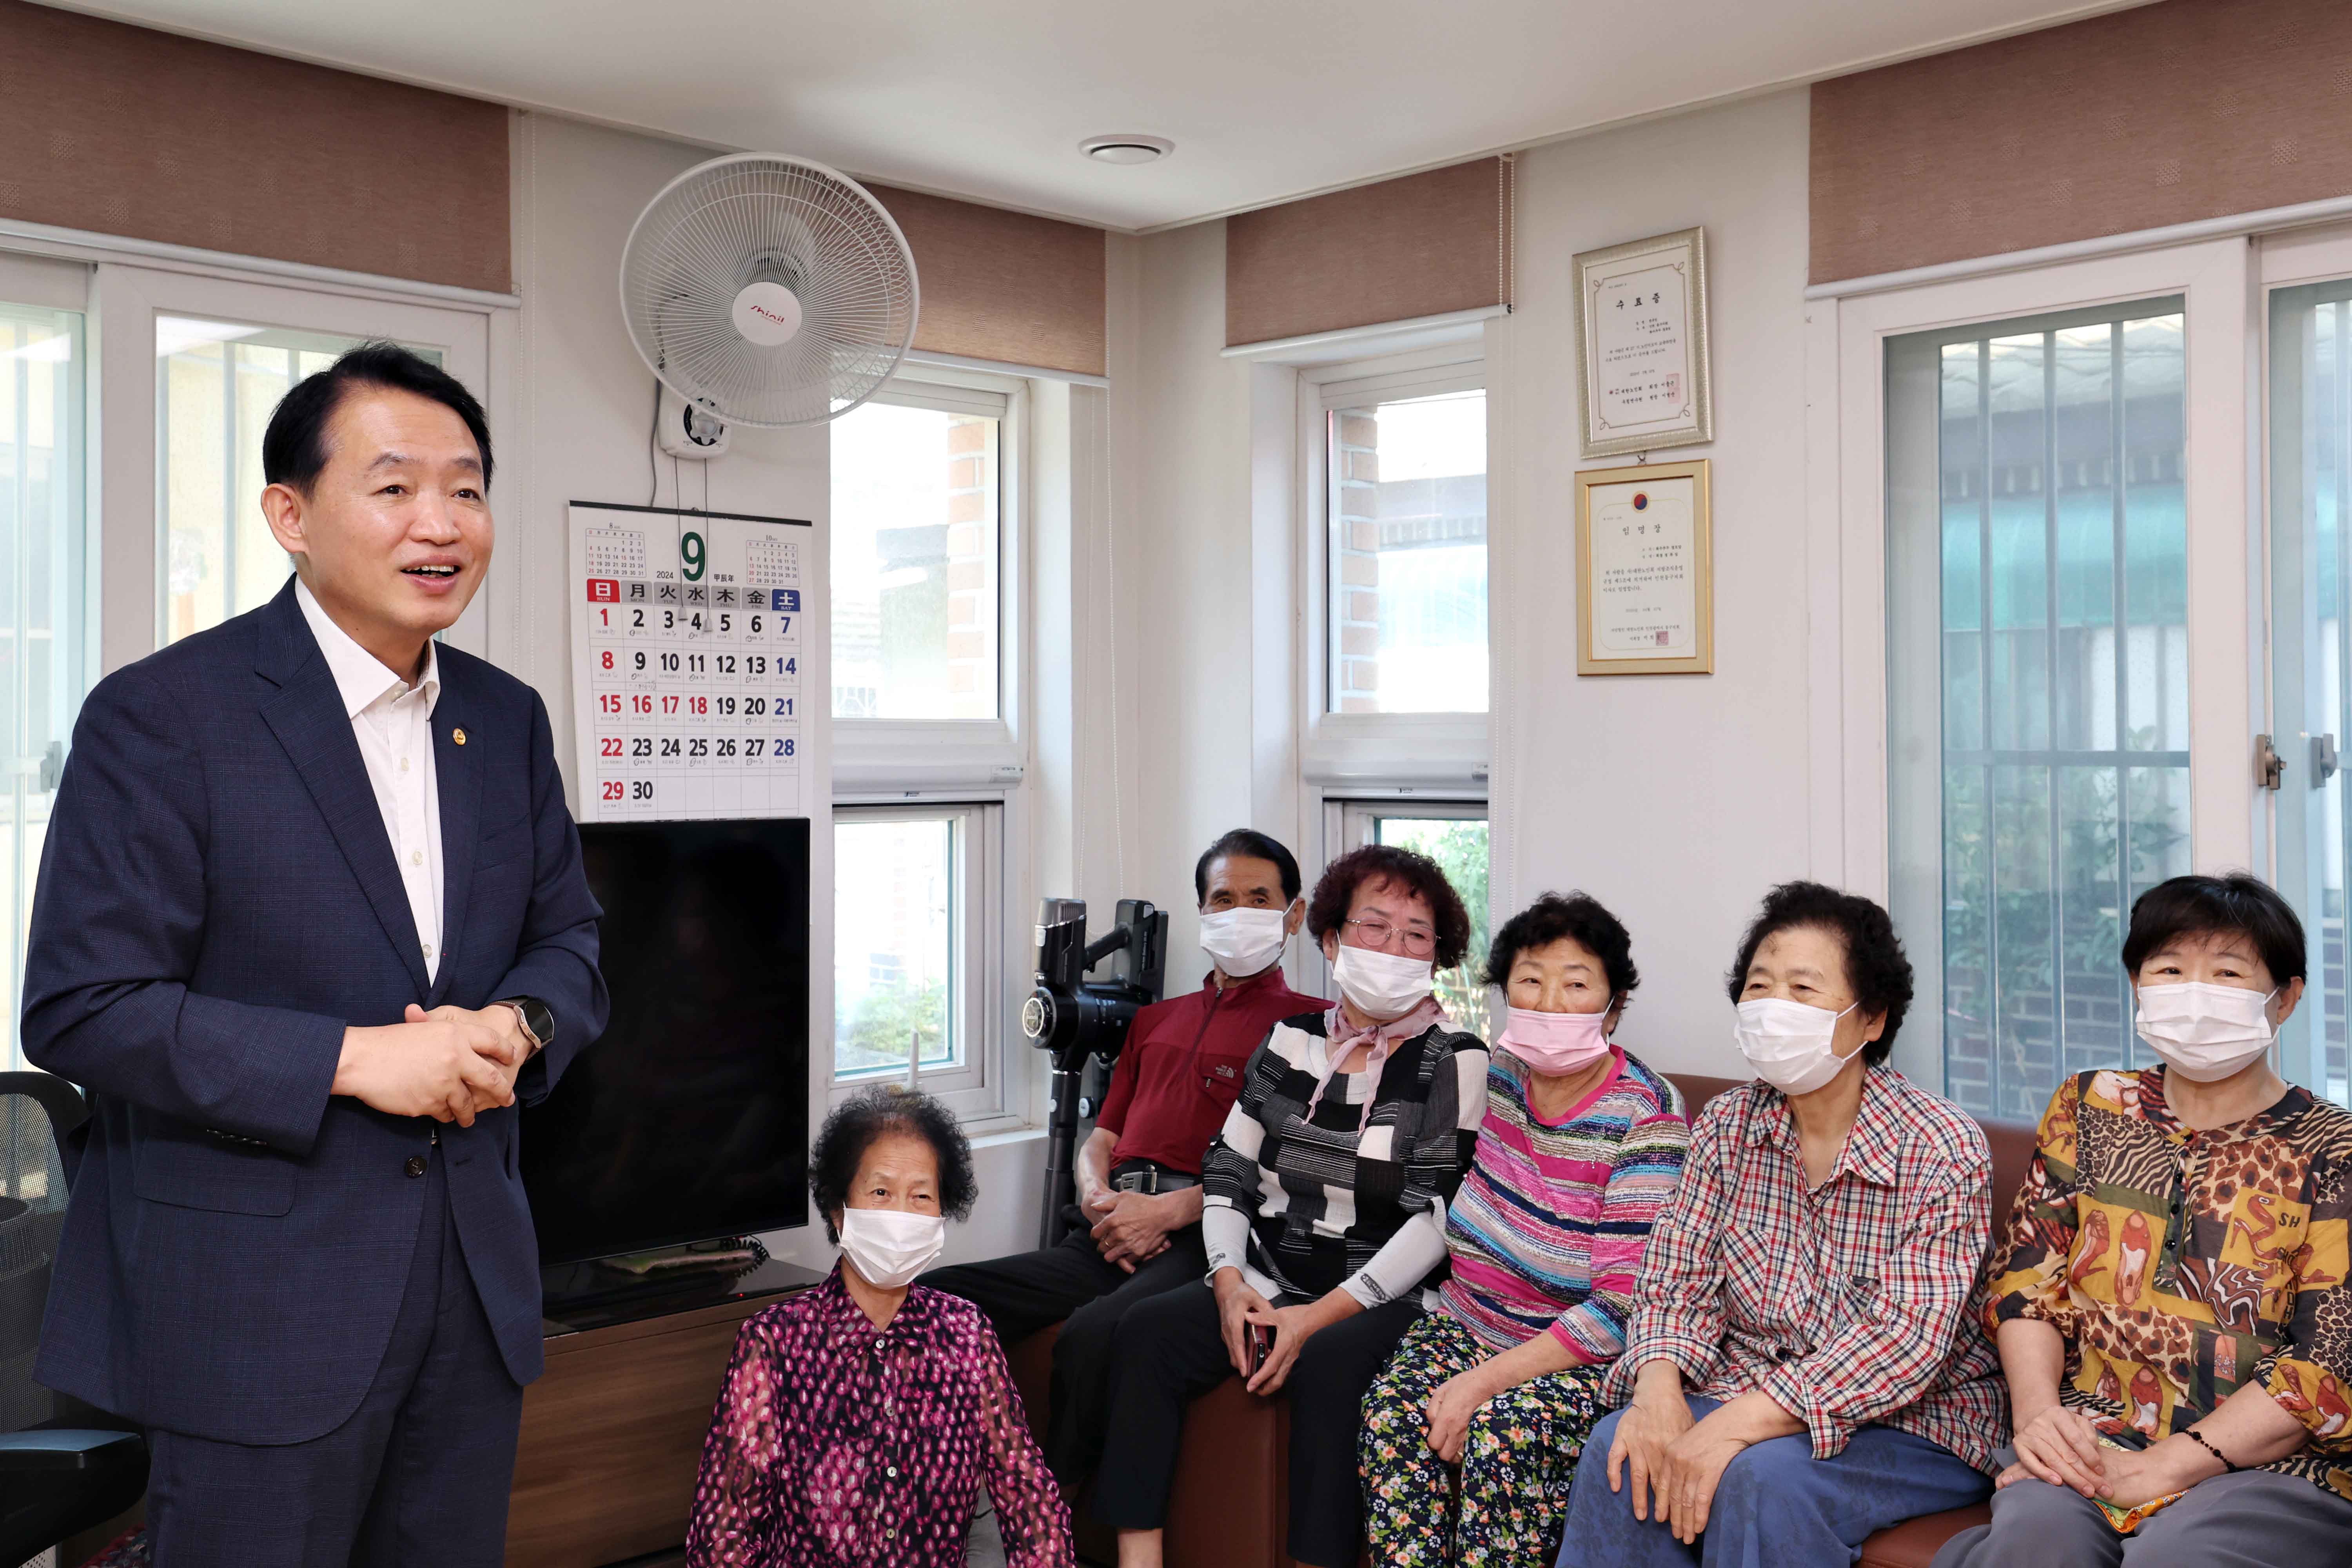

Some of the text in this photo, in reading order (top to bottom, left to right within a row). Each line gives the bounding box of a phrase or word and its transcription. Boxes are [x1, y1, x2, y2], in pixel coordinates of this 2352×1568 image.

[681, 532, 705, 581] 9
[657, 571, 673, 579] 2024
[714, 573, 734, 582] 甲辰年
[595, 583, 795, 606] 日 月 火 水 木 金 土
[601, 608, 790, 633] 1 2 3 4 5 6 7
[602, 652, 796, 674] 8 9 10 11 12 13 14
[600, 695, 792, 715] 15 16 17 18 19 20 21
[601, 738, 794, 756] 22 23 24 25 26 27 28
[603, 781, 653, 800] 29 30
[2278, 1212, 2301, 1228] SH
